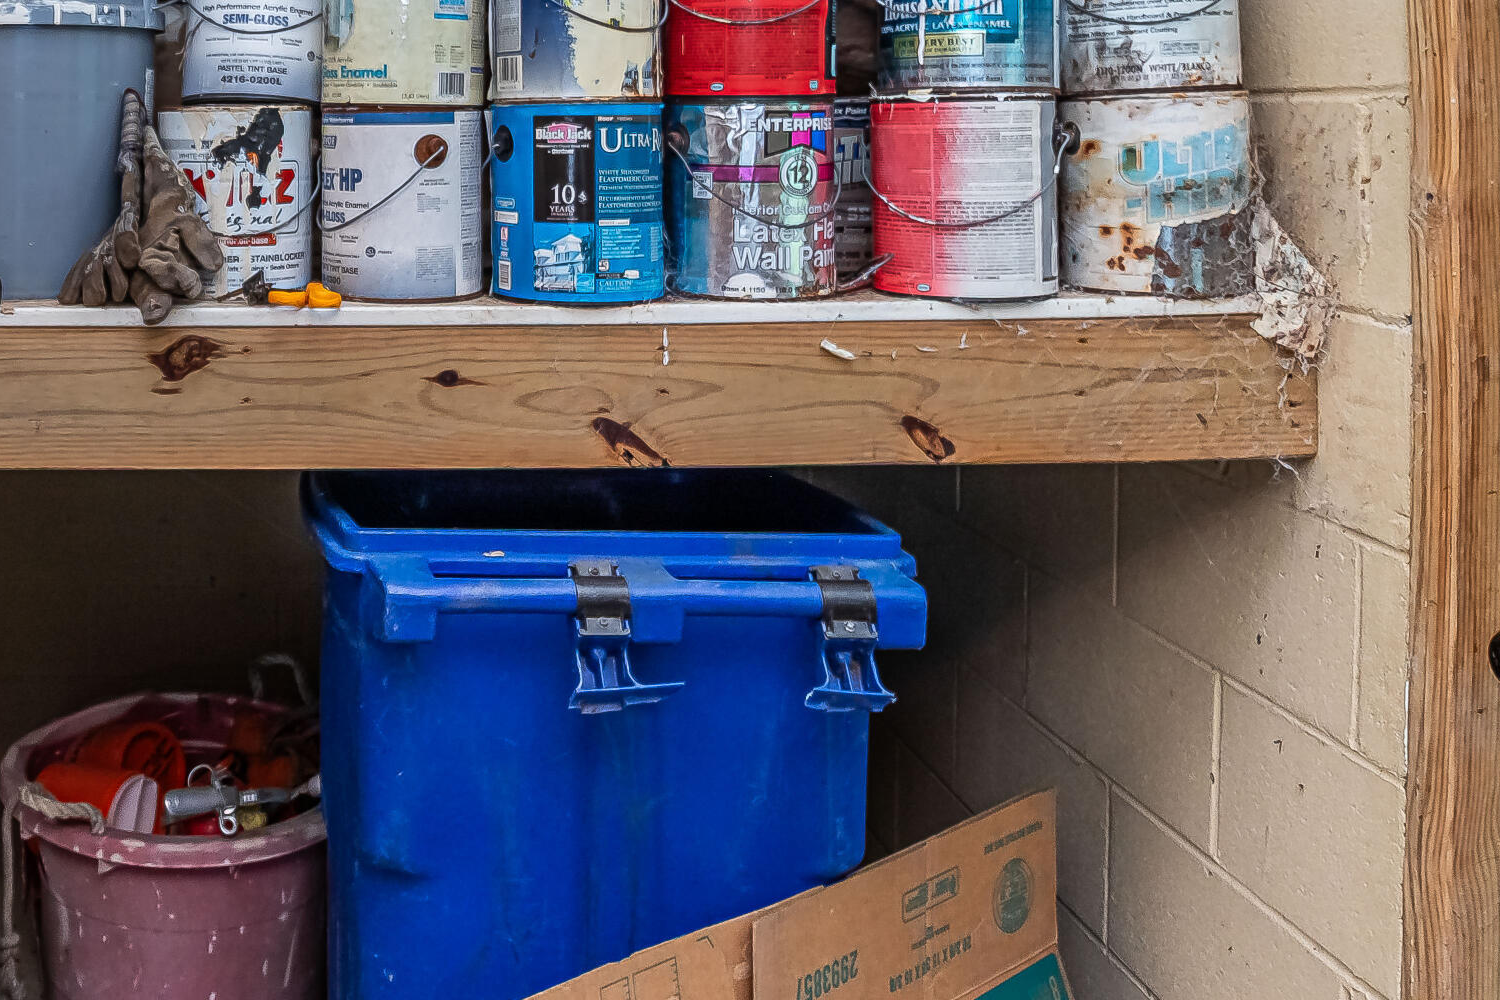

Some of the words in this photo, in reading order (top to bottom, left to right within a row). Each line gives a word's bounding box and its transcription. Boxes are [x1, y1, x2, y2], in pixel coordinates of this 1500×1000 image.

[216, 3, 260, 11] Performance
[263, 4, 288, 13] Acrylic
[289, 7, 314, 17] Enamel
[222, 14, 289, 27] SEMI-GLOSS
[247, 65, 265, 73] TINT
[267, 66, 288, 75] BASE
[340, 64, 387, 79] Enamel
[535, 127, 564, 140] Black
[567, 126, 592, 140] Jack
[789, 161, 810, 184] 12
[339, 168, 363, 192] HP
[550, 184, 576, 204] 10
[345, 201, 370, 209] Enamel
[550, 205, 576, 213] YEARS
[734, 219, 807, 242] Latex
[732, 246, 790, 270] Wall
[341, 266, 359, 275] BASE
